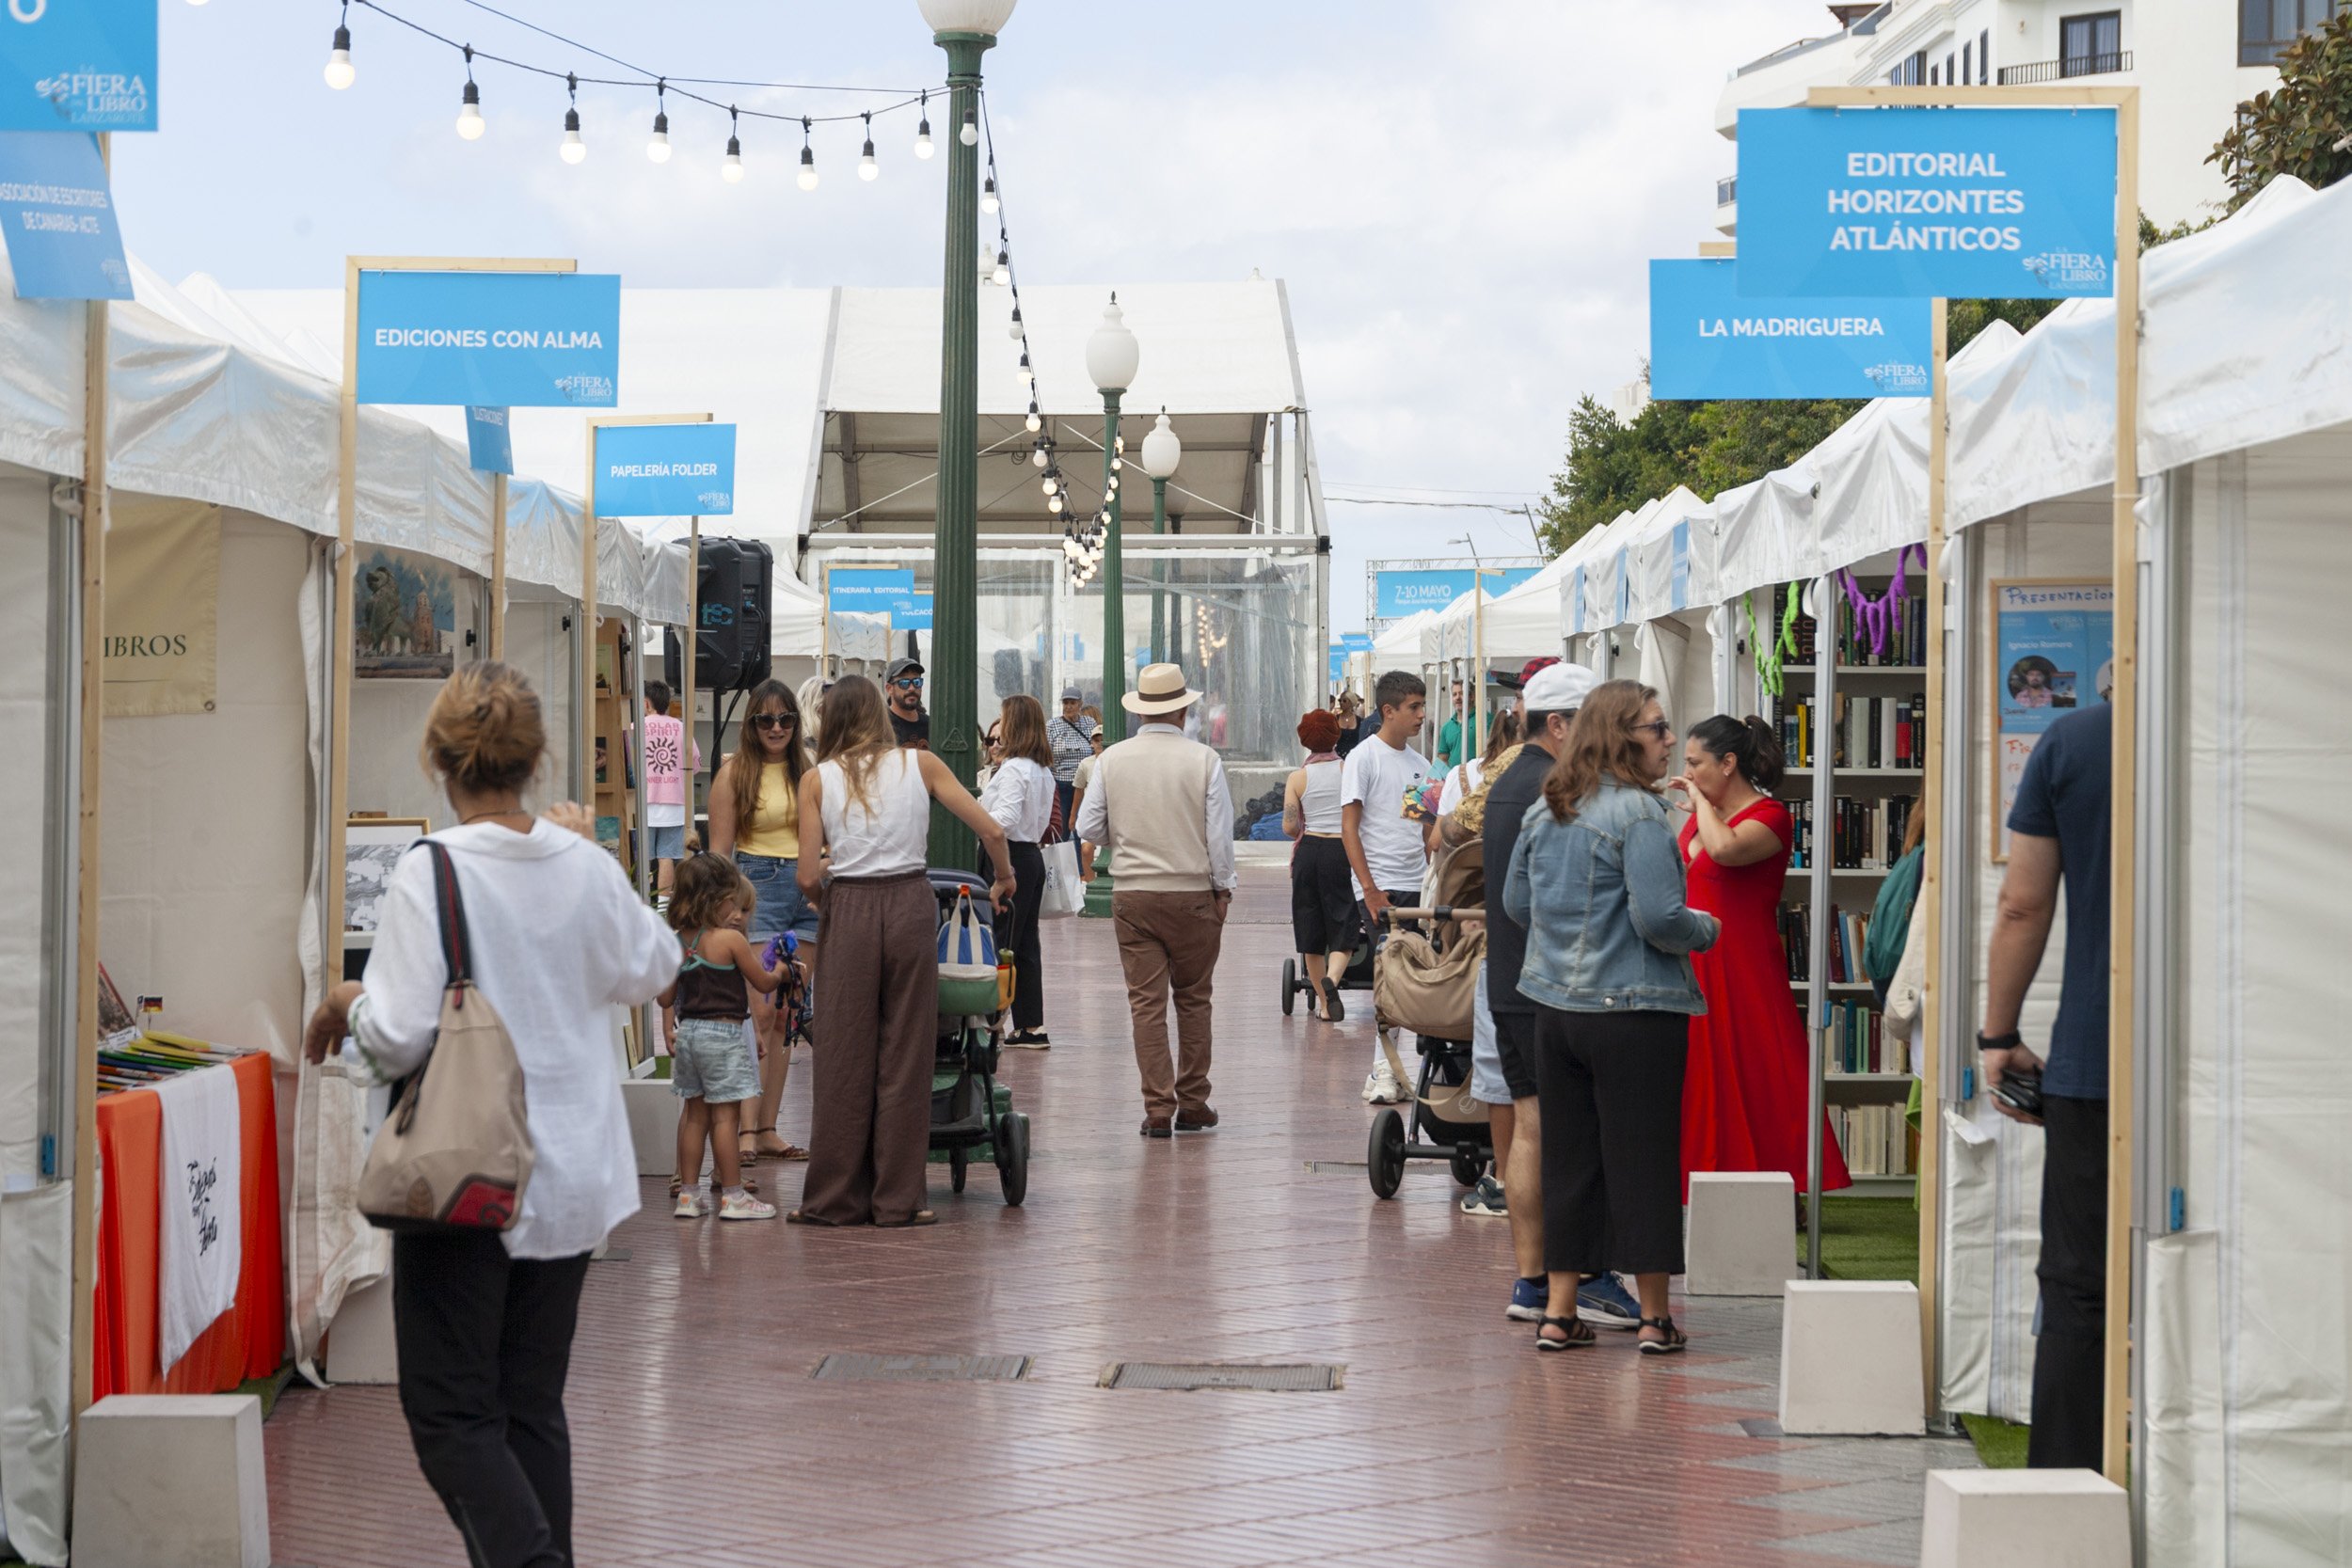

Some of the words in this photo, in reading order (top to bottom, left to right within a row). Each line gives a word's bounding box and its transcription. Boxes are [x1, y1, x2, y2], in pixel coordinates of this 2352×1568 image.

[72, 74, 147, 95] FIERA
[87, 95, 148, 112] LIBRO
[1847, 152, 2007, 177] EDITORIAL
[1827, 189, 2025, 214] HORIZONTES
[1829, 220, 2022, 251] ATLÁNTICOS
[2049, 253, 2106, 269] FIERA
[2061, 270, 2106, 281] LIBRO
[1699, 319, 1728, 337] LA
[1733, 317, 1884, 337] MADRIGUERA
[375, 329, 487, 347] EDICIONES
[492, 330, 538, 348] CON
[543, 331, 603, 349] ALMA
[1884, 365, 1926, 376] FIERA
[574, 376, 612, 388] FIERA
[1893, 376, 1927, 386] LIBRO
[580, 388, 612, 397] LIBRO
[611, 462, 670, 478] PAPELERÍA
[673, 464, 718, 476] FOLDER
[1395, 585, 1418, 598] 7-10
[1419, 585, 1452, 597] MAYO
[103, 634, 186, 657] IBROS
